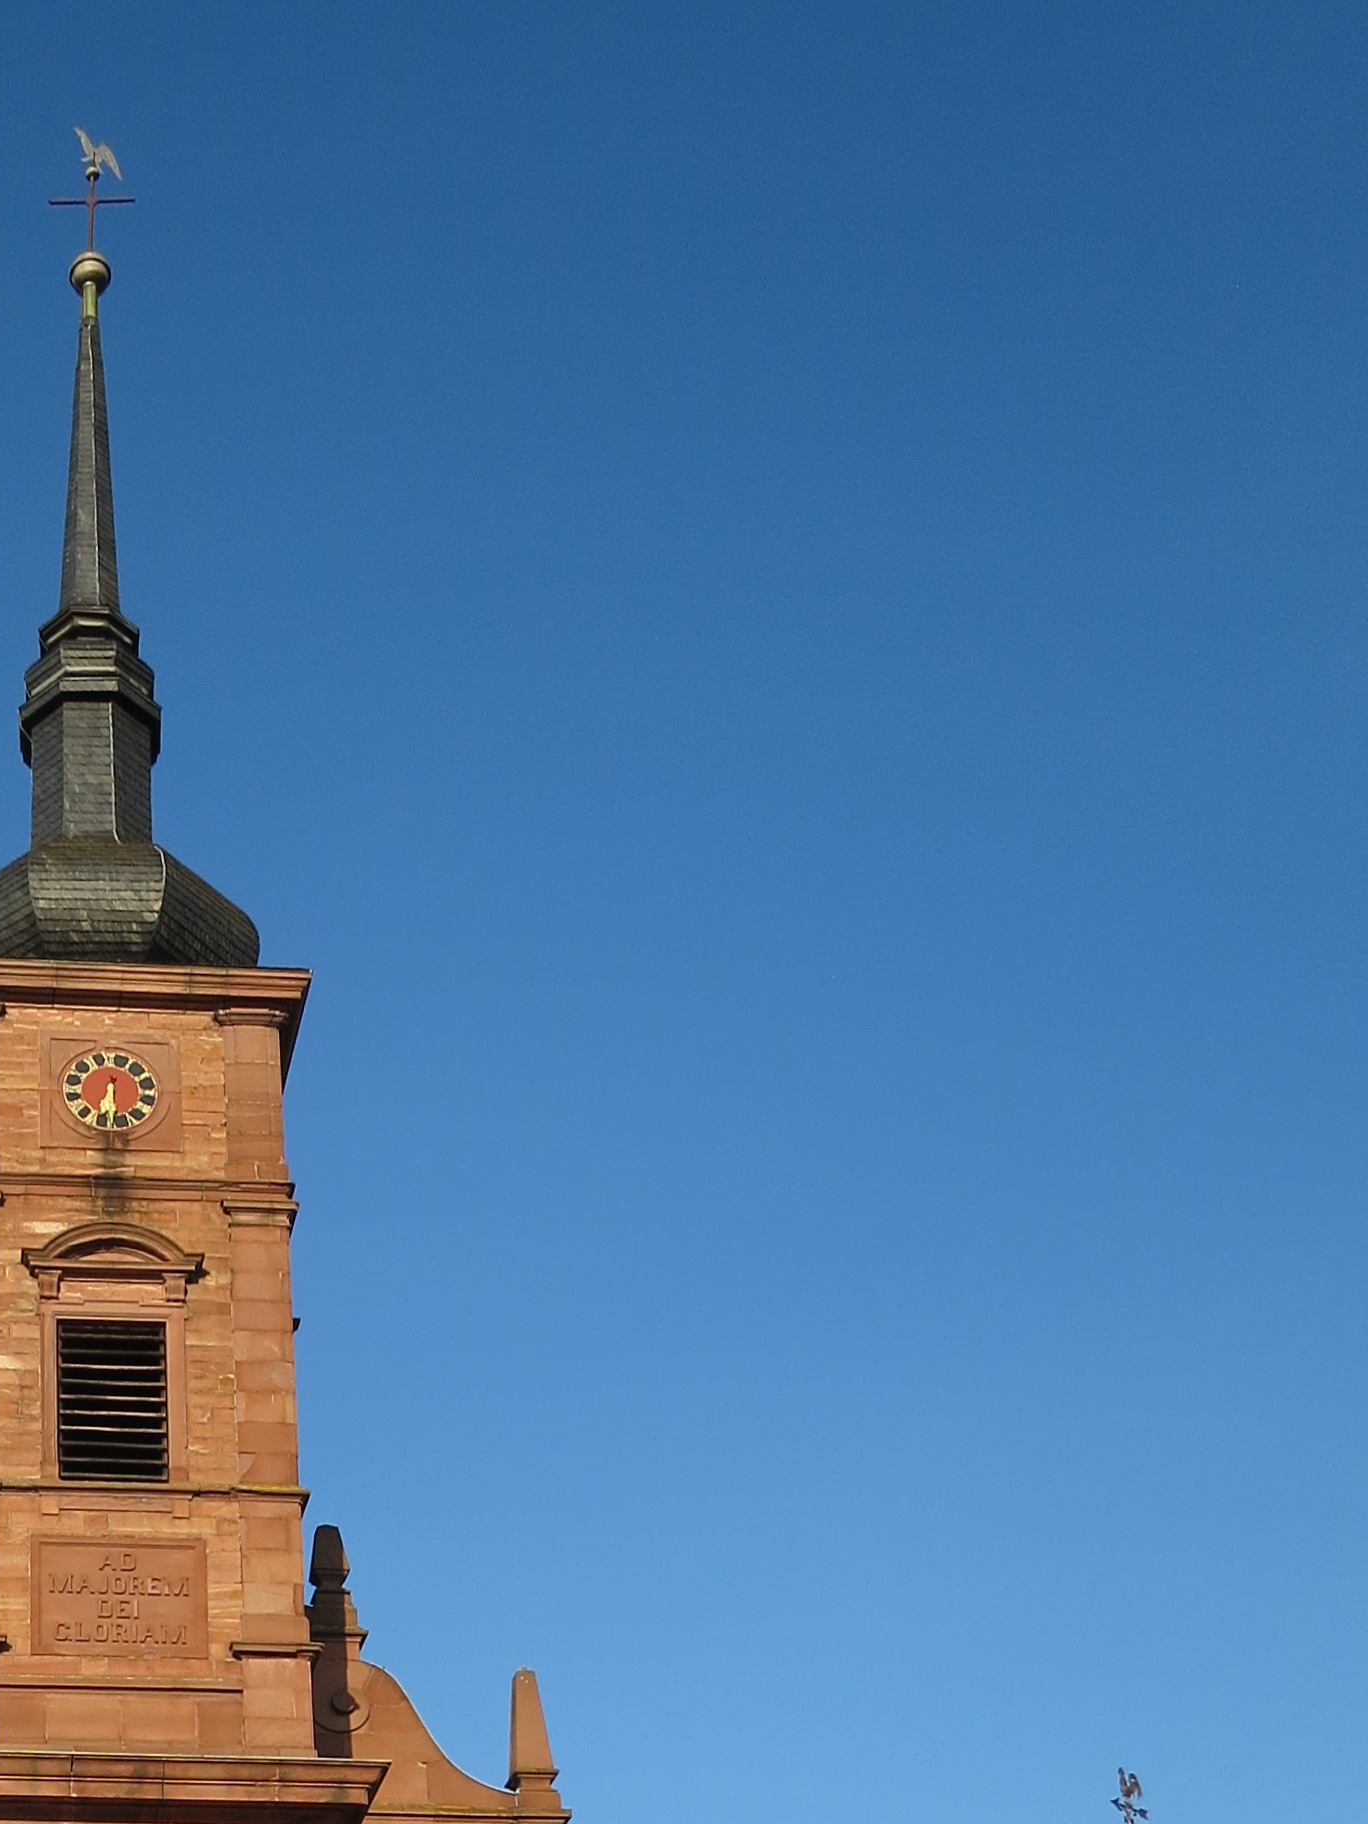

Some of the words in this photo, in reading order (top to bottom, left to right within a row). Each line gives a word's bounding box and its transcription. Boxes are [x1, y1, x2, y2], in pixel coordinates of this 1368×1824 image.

[98, 1552, 137, 1572] AD
[48, 1573, 190, 1597] MAJOREM
[97, 1599, 140, 1620] DEI
[53, 1622, 188, 1645] GLORIAM
